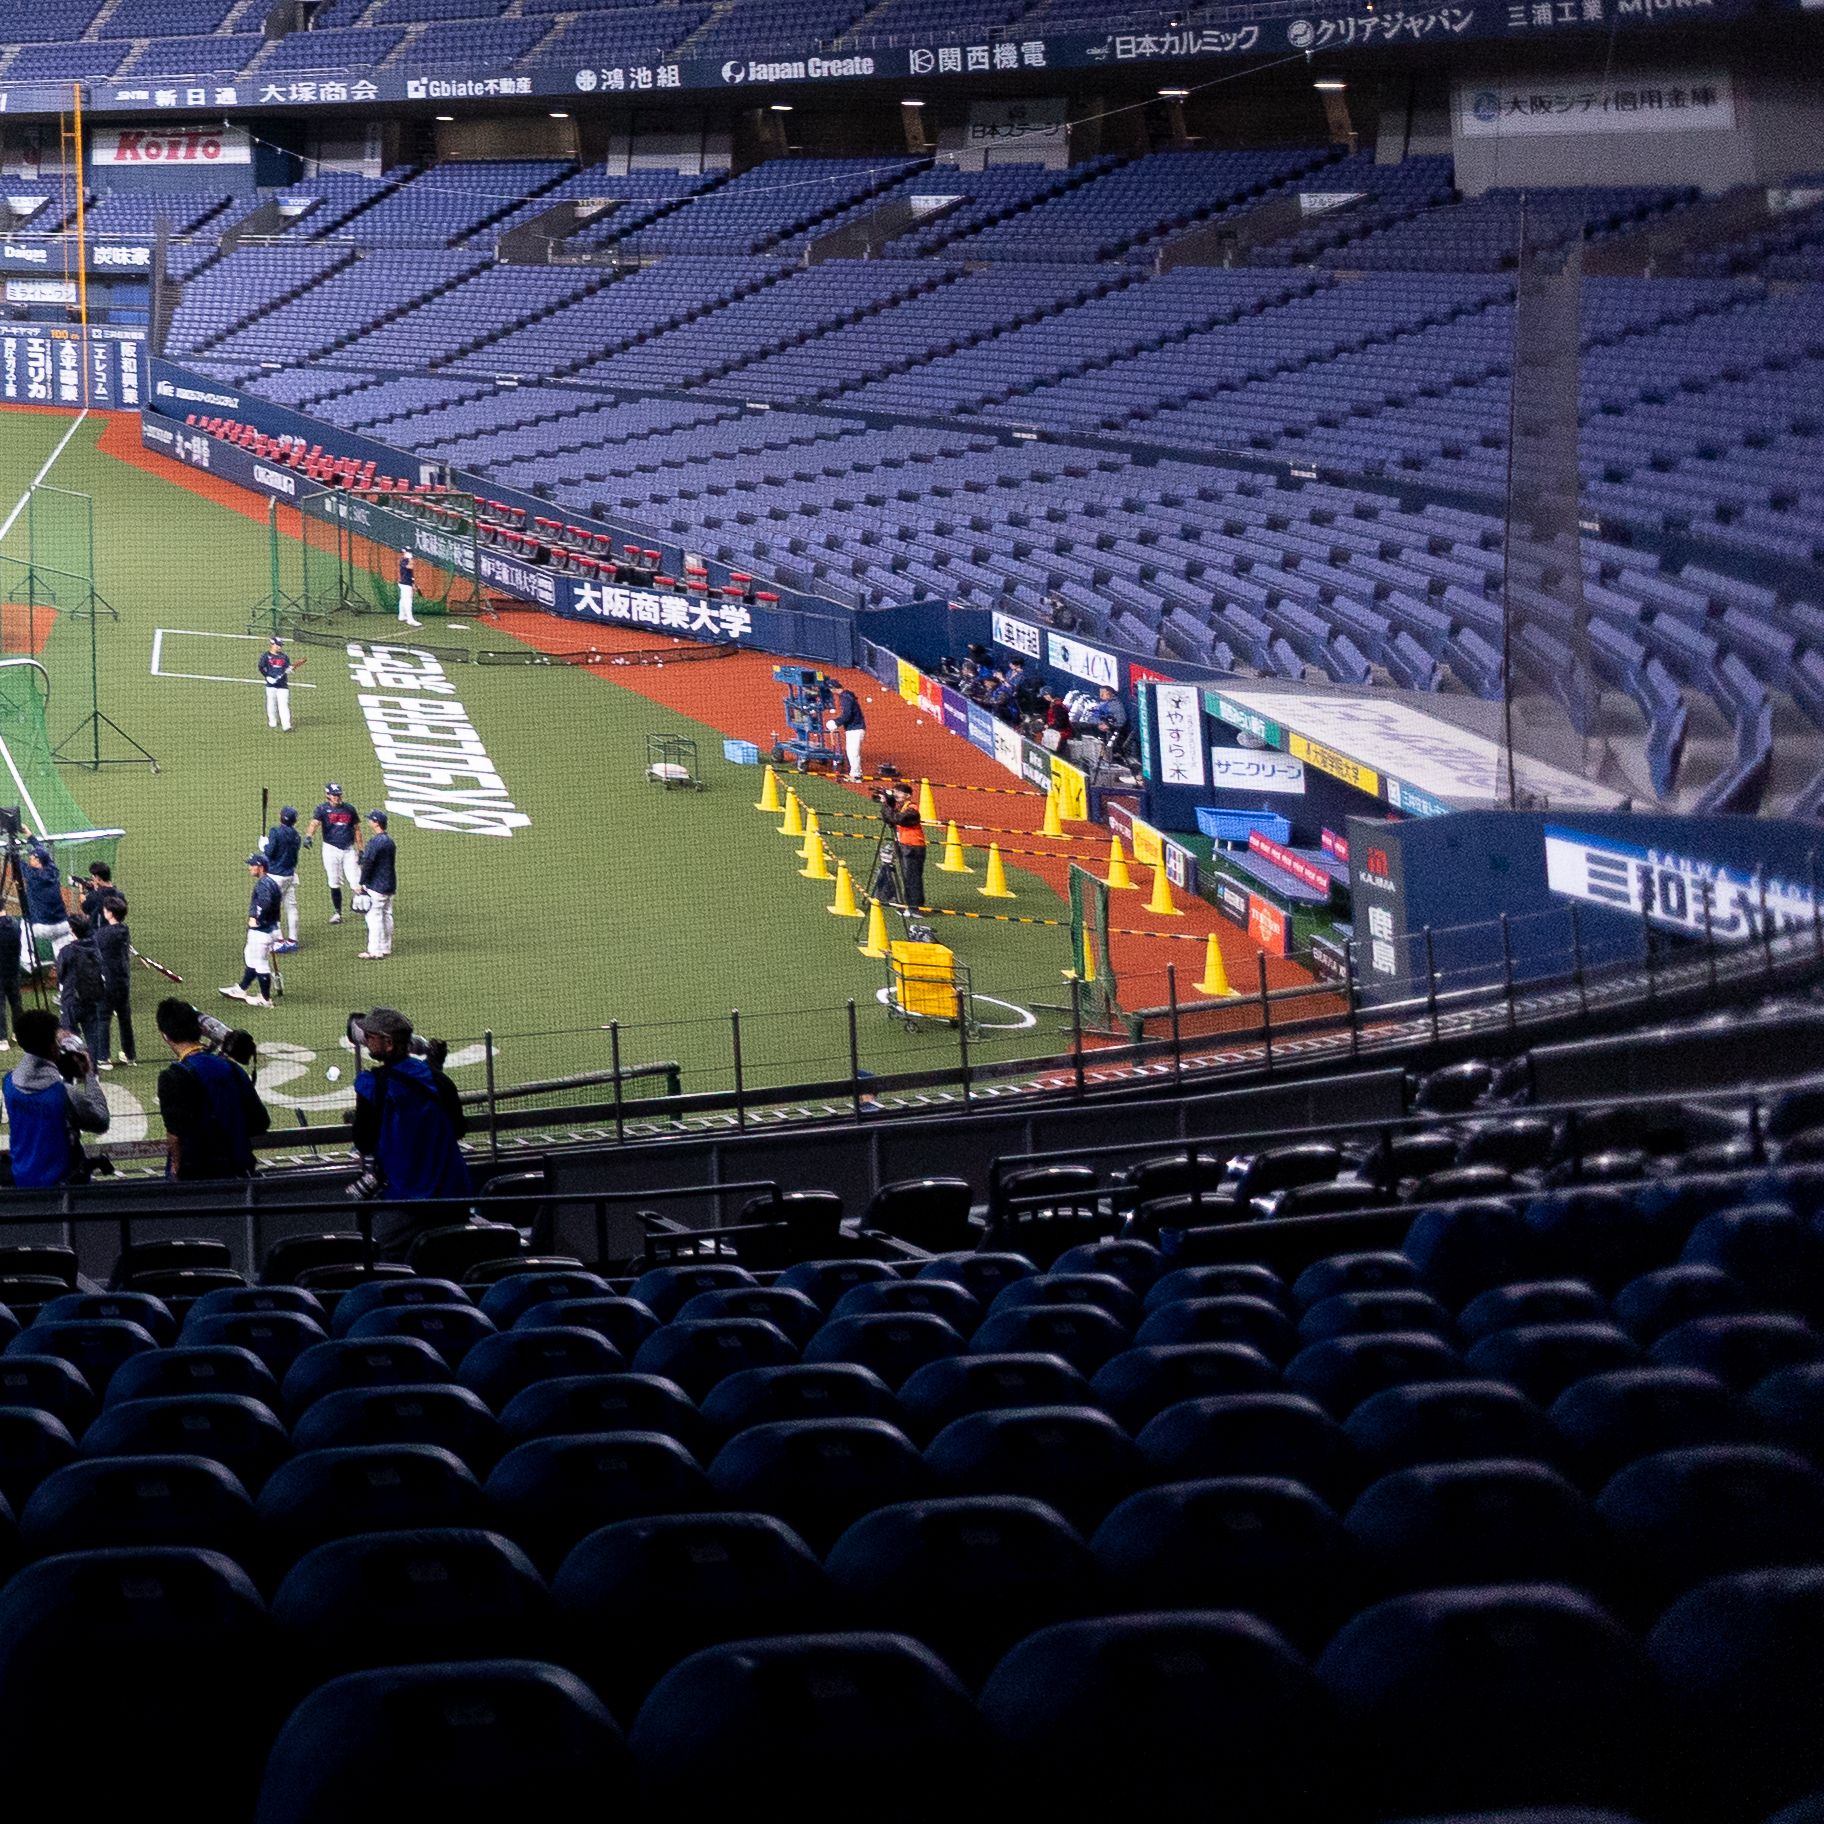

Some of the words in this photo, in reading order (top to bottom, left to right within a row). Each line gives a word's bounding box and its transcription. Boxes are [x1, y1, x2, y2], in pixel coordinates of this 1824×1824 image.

[1315, 7, 1474, 44] クリアジャパン
[939, 41, 1047, 73] 関西機電
[1116, 25, 1259, 59] 日本カルミック
[601, 65, 681, 91] 鴻池組
[748, 61, 805, 82] Japan
[808, 55, 874, 78] Create
[155, 88, 237, 107] 新日通
[259, 79, 379, 103] 大塚商会
[93, 246, 151, 265] 炭味家
[27, 338, 46, 399] エコリカ
[94, 347, 109, 395] エレコム
[573, 584, 752, 639] 大阪商業大学
[1214, 758, 1302, 778] サニクリーン
[1367, 905, 1397, 976] 鹿島
